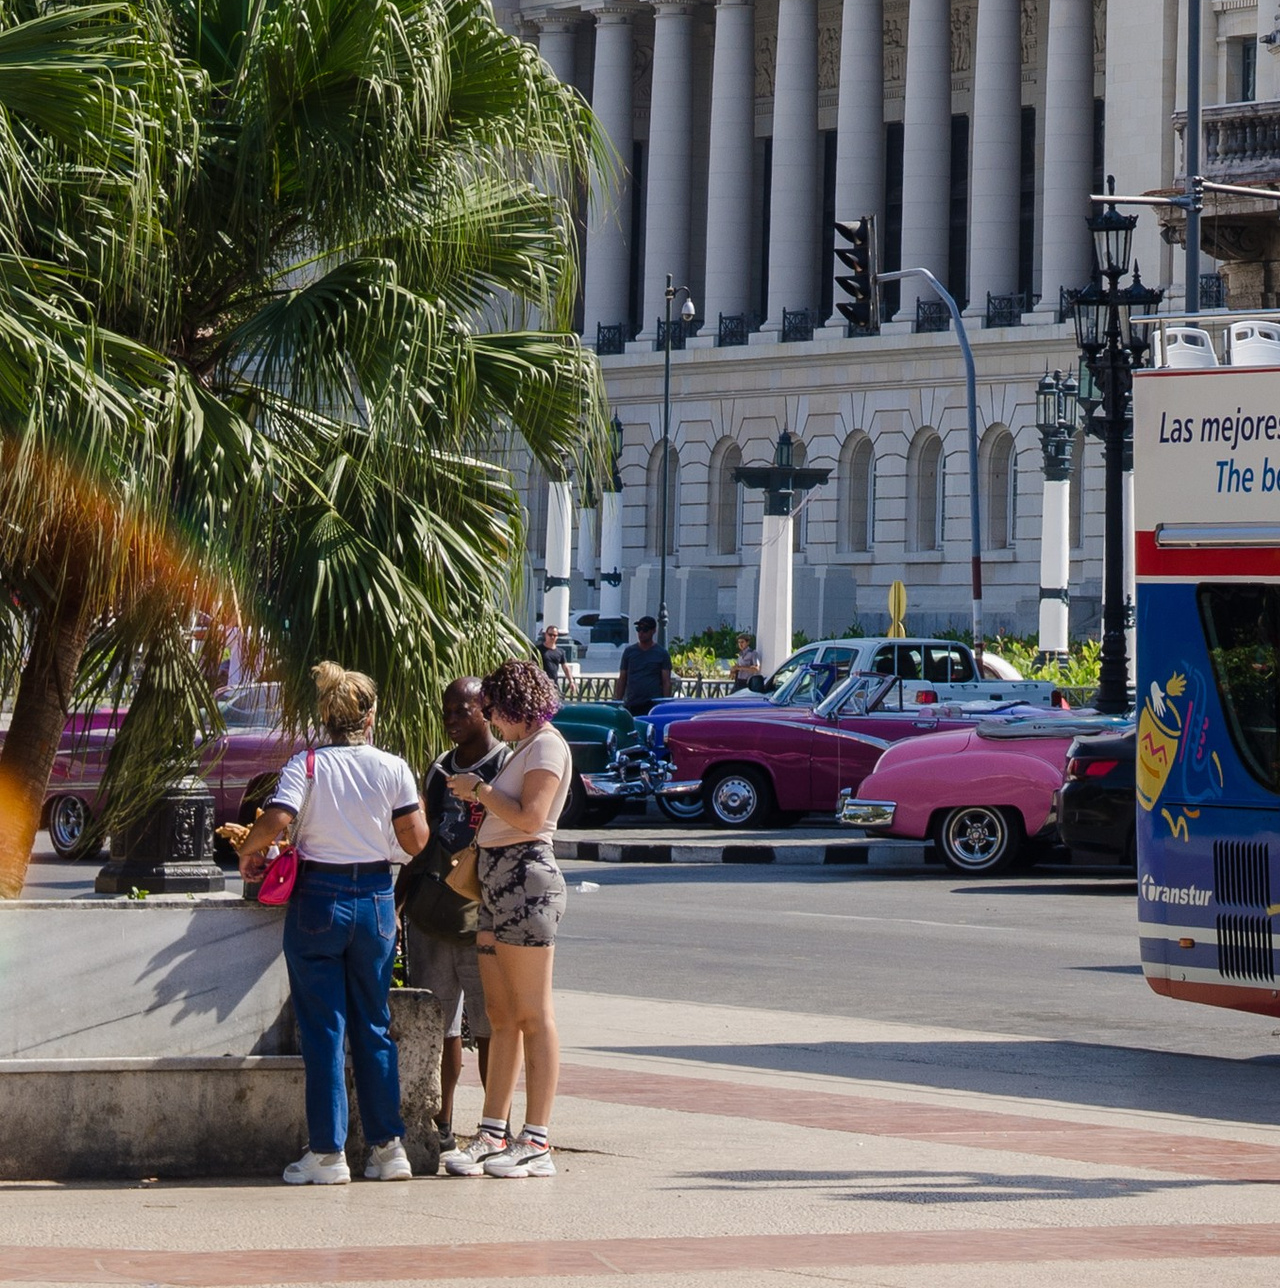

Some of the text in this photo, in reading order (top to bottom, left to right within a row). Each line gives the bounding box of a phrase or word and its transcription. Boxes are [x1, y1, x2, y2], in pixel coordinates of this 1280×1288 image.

[1159, 411, 1194, 443] Las
[1216, 458, 1254, 493] The
[1141, 873, 1213, 906] transtur
